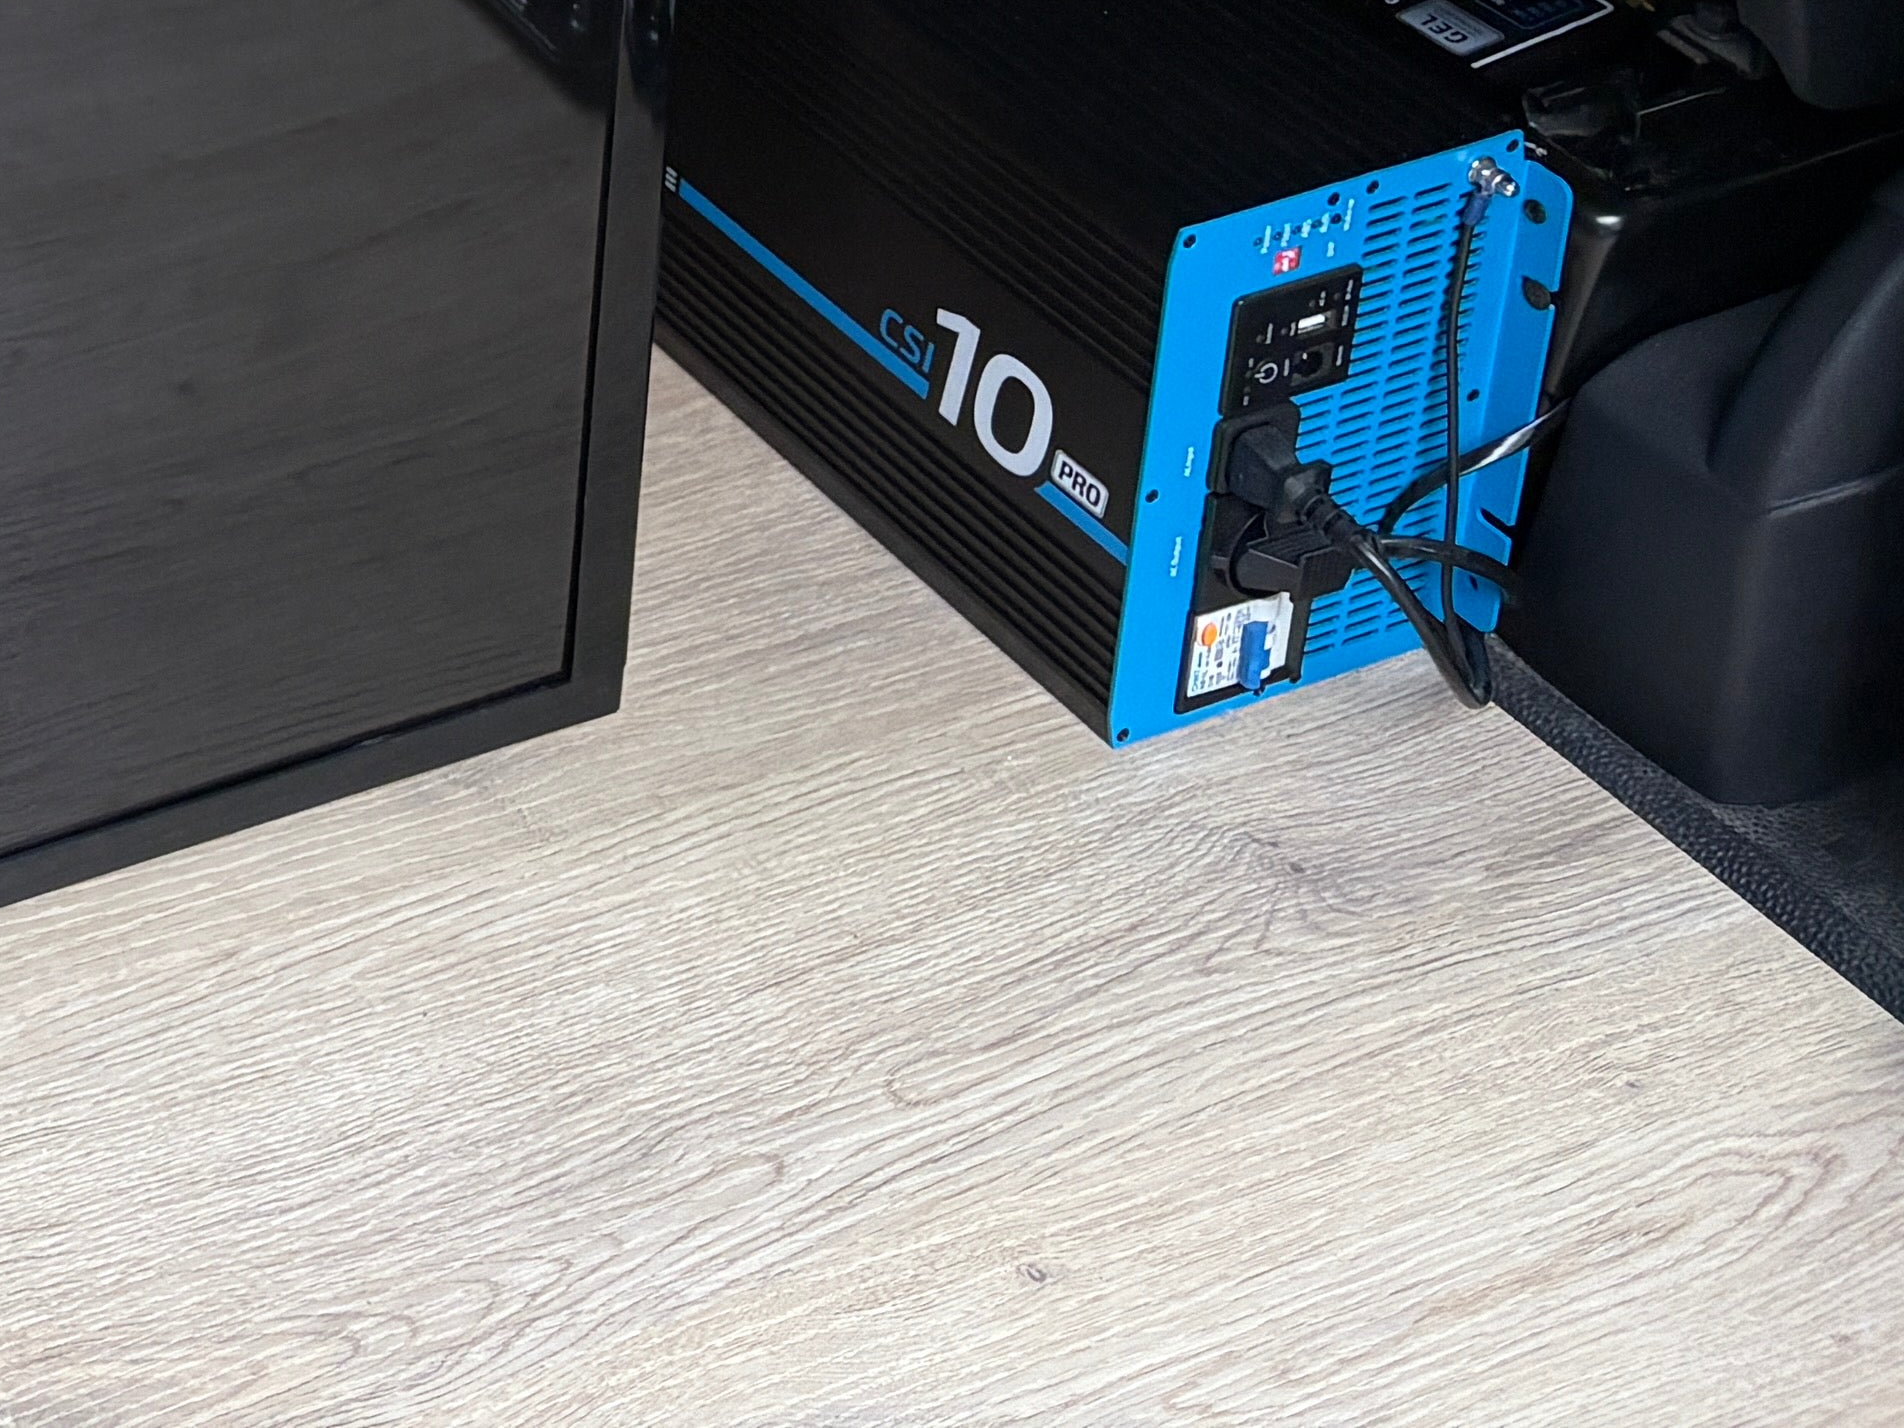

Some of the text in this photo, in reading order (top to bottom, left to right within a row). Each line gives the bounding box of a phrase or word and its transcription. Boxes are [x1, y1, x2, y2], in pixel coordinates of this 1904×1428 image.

[1422, 13, 1468, 44] GEL
[880, 307, 1102, 508] CSI 10 PRO
